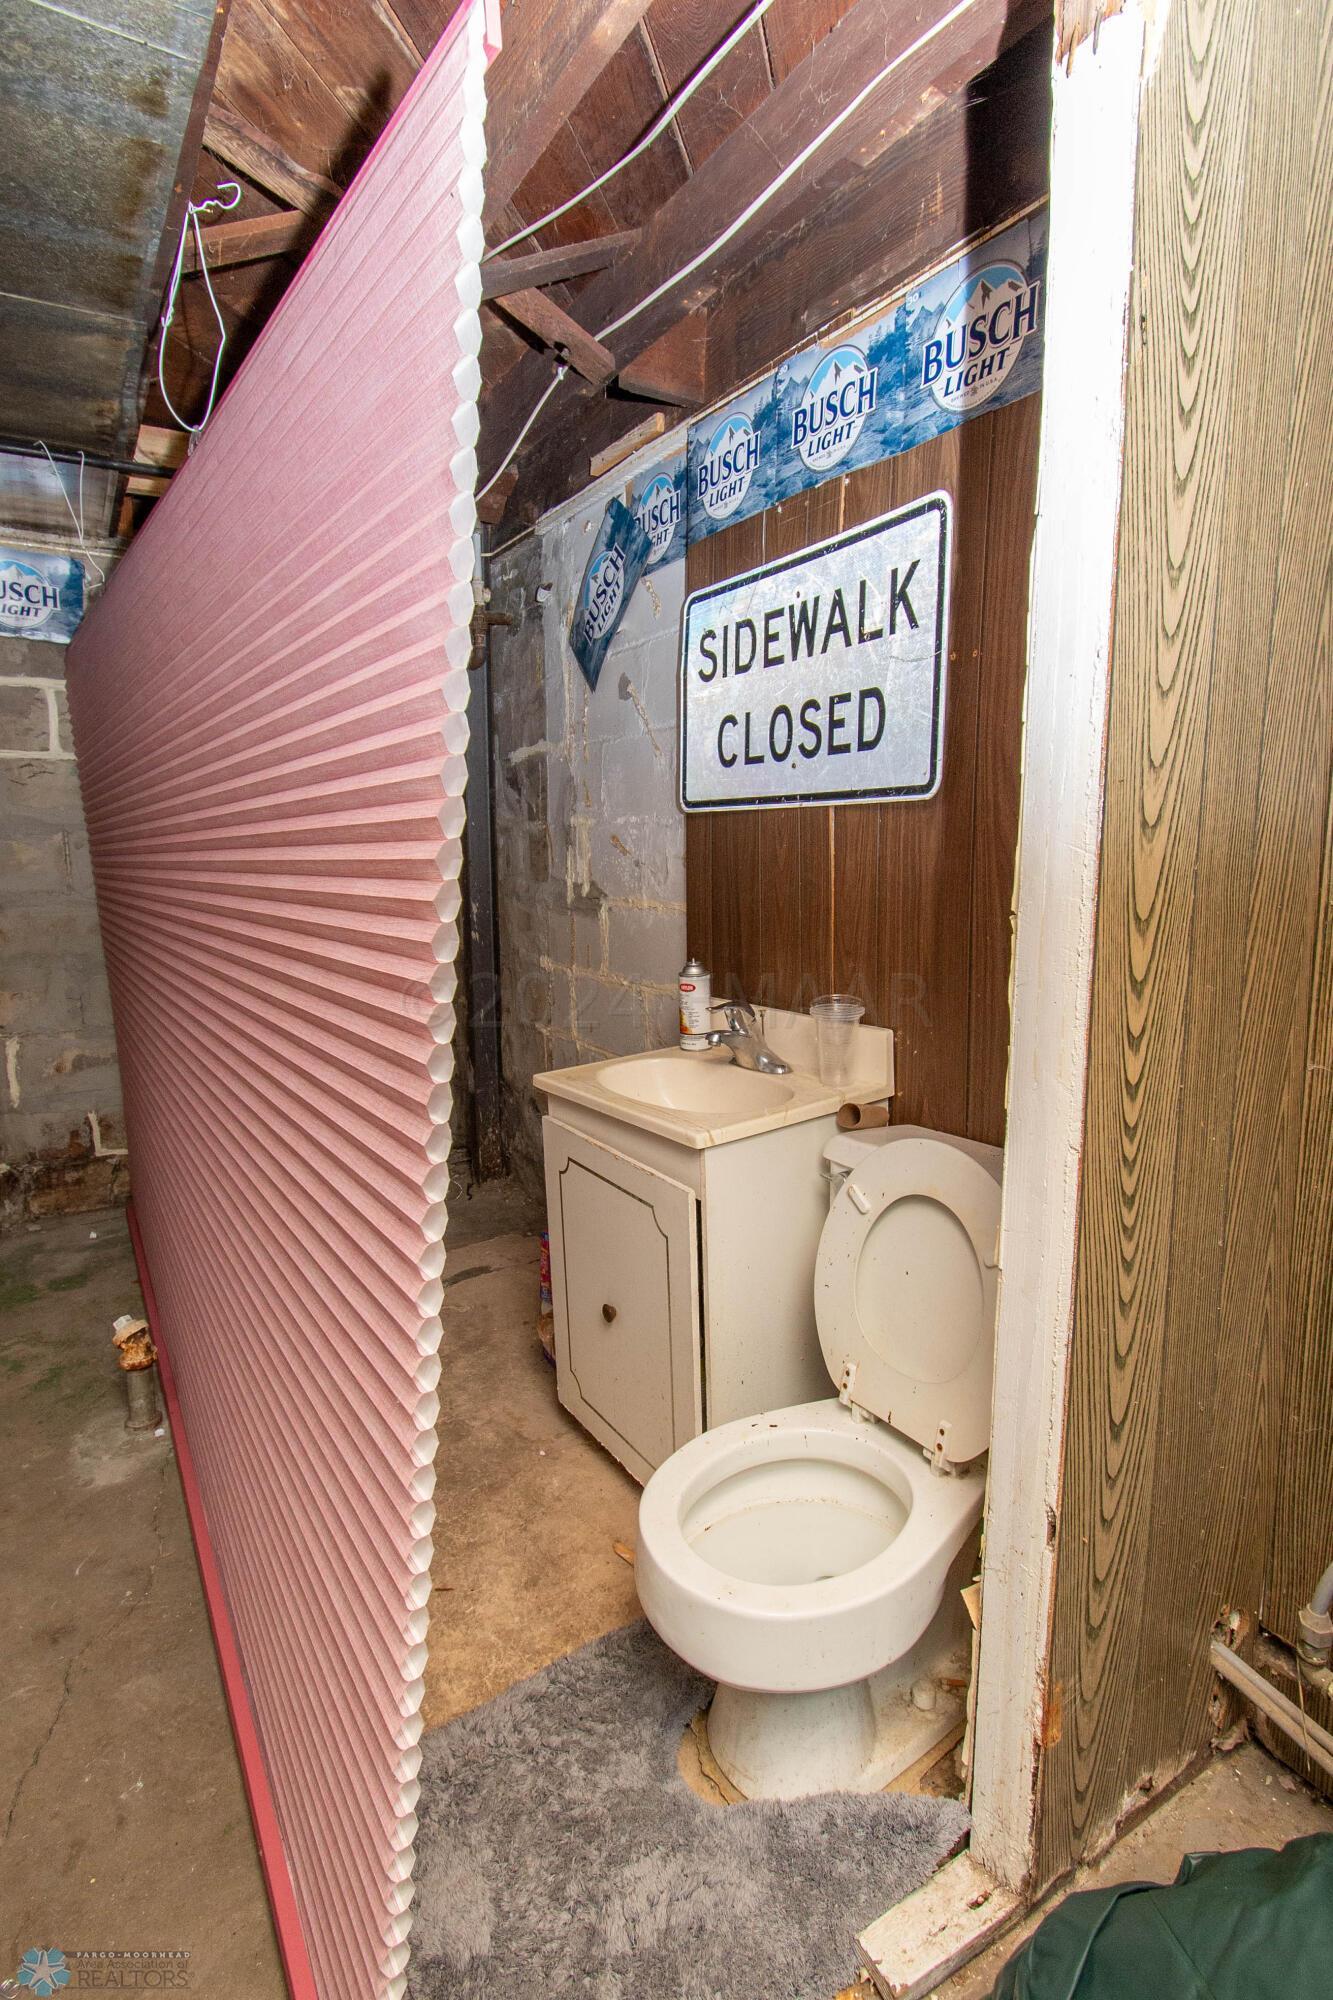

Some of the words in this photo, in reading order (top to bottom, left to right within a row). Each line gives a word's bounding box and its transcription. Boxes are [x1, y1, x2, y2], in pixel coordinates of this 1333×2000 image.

[922, 282, 1039, 386] BUSCH
[943, 348, 1010, 398] LIGHT
[793, 371, 876, 446] BUSCH
[807, 421, 856, 458] LIGHT
[698, 433, 760, 497] BUSCH
[709, 476, 745, 508] LIGHT
[1, 603, 42, 618] IGHT
[584, 545, 625, 641] BUSCH
[598, 577, 621, 632] LIGHT
[698, 559, 921, 683] SIDEWALK
[717, 686, 886, 768] CLOSED
